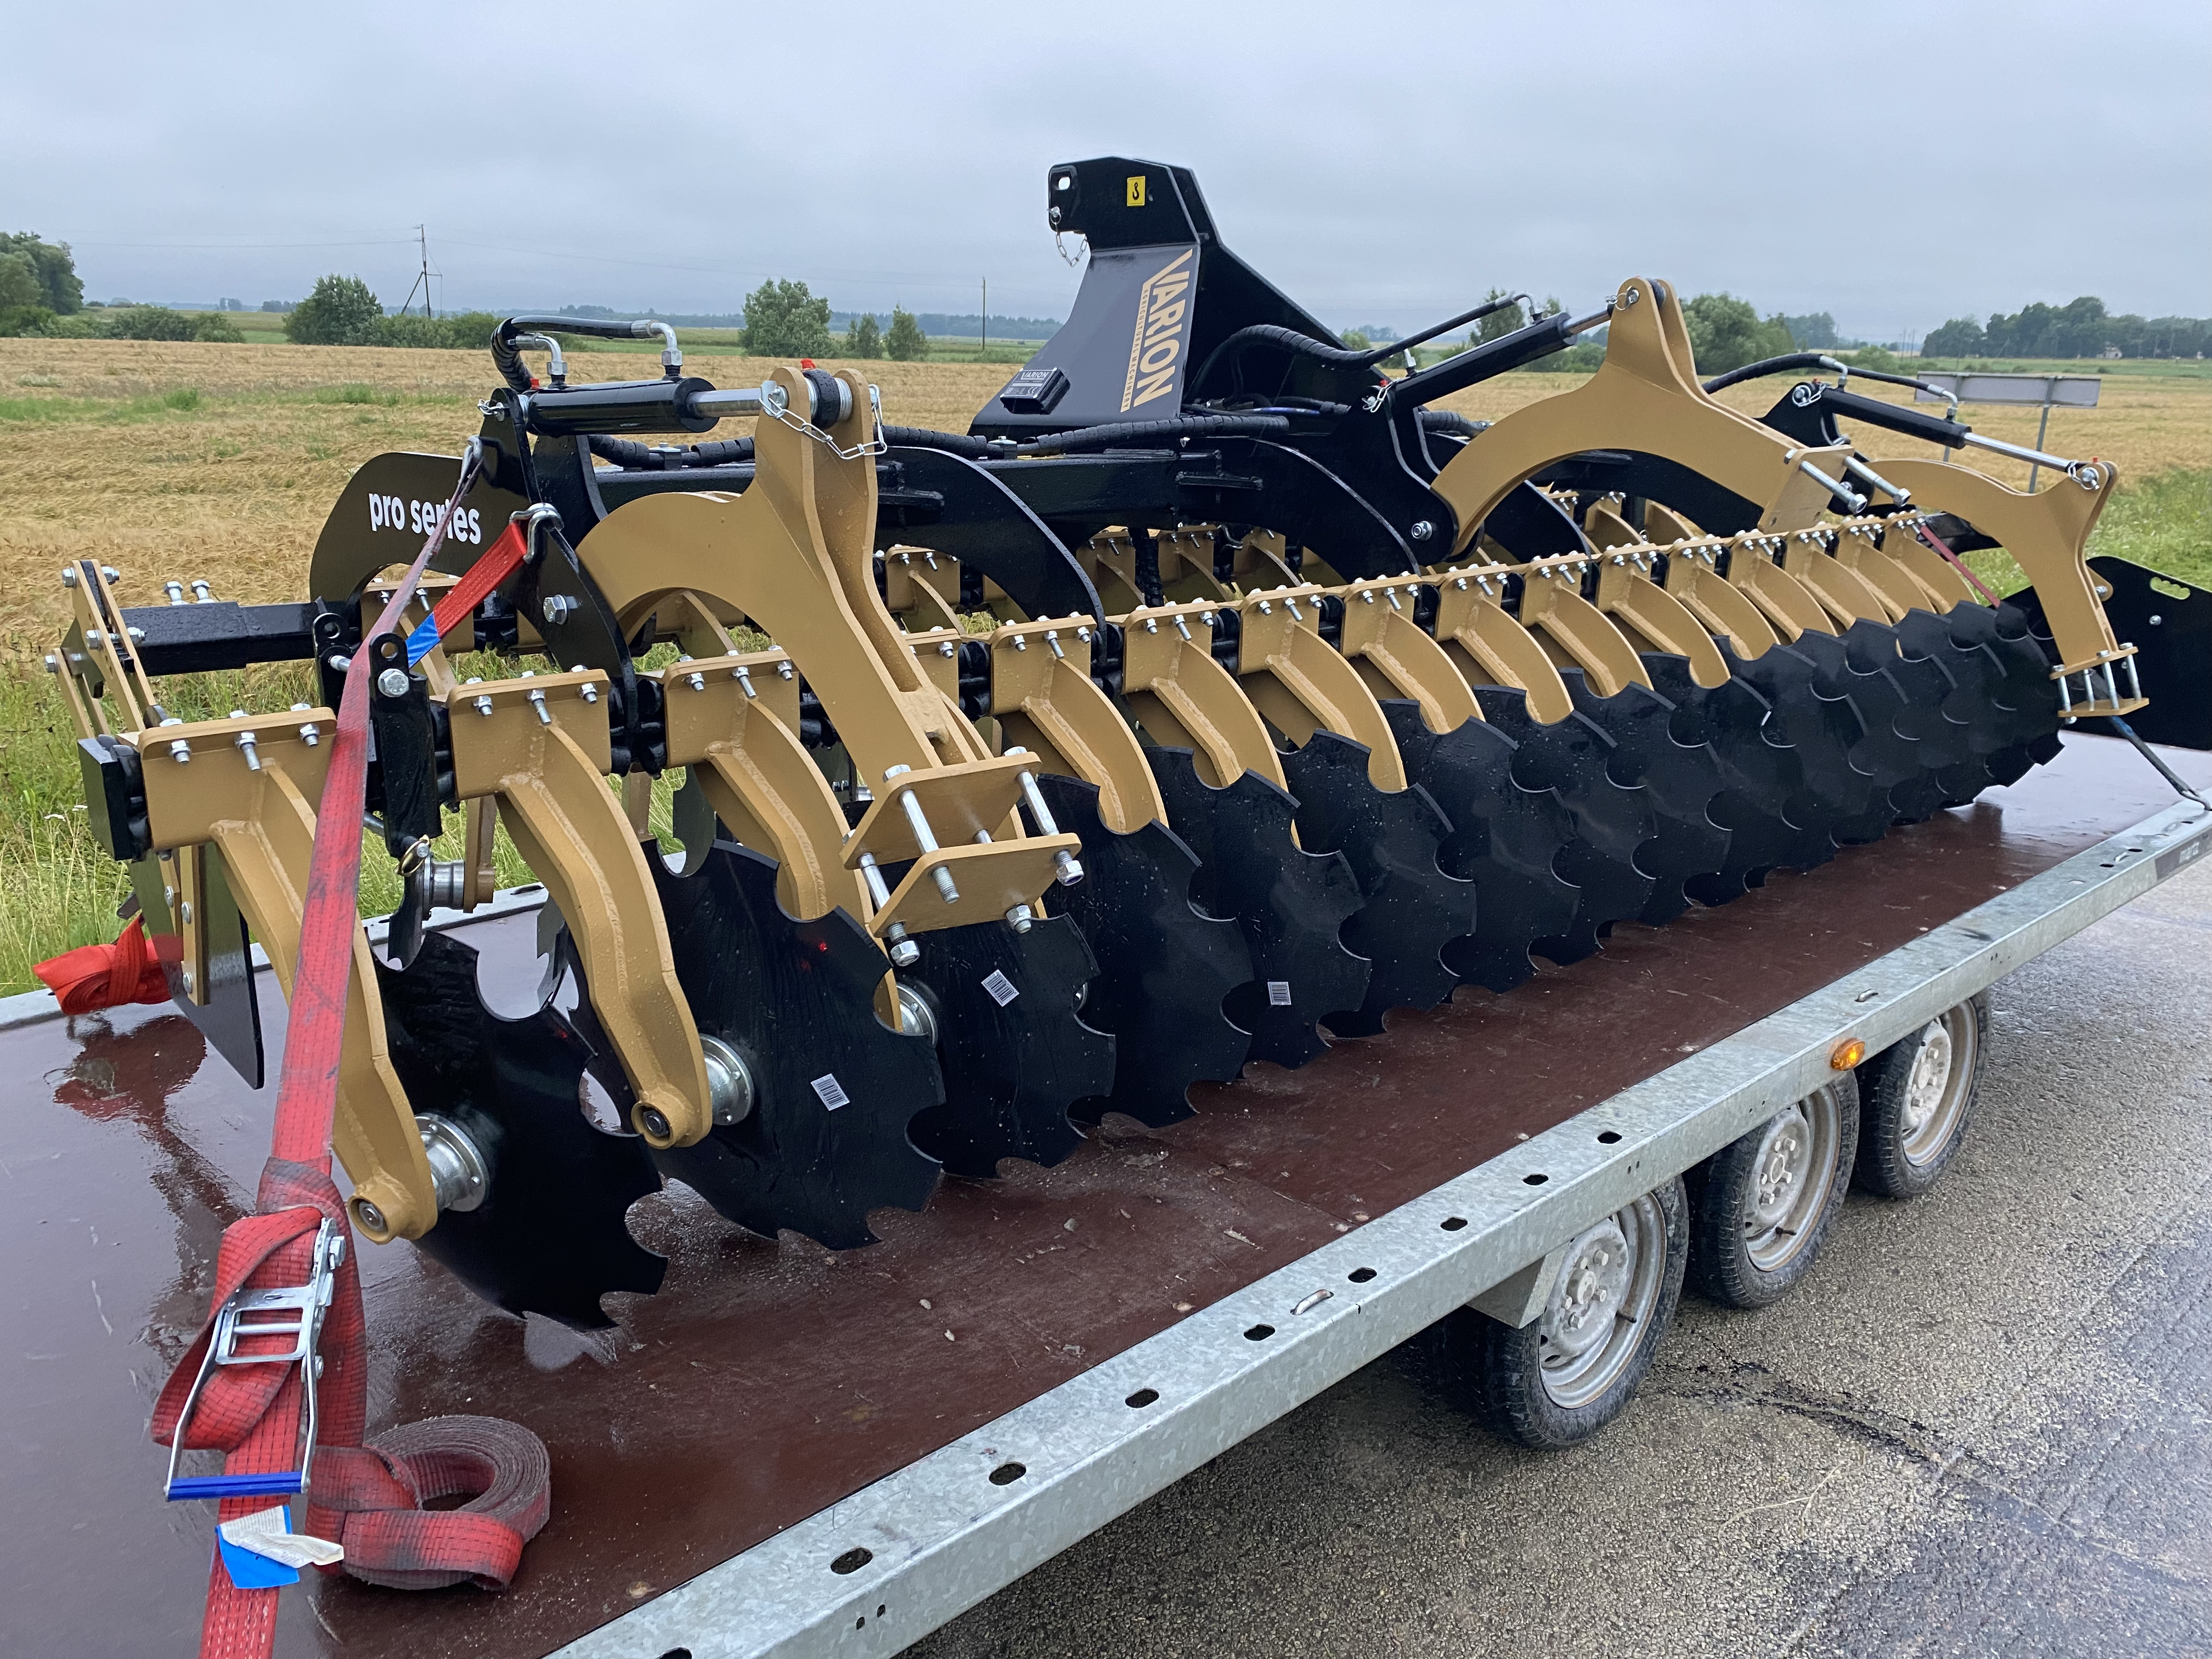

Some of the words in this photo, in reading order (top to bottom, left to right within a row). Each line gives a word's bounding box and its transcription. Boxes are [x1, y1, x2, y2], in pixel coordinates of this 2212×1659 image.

[1133, 289, 1149, 353] AGRICULTURAL
[1133, 249, 1193, 407] VARION
[1021, 371, 1048, 380] VARION
[1122, 356, 1138, 408] MACHINERY
[369, 493, 405, 532] pro
[410, 498, 481, 544] series
